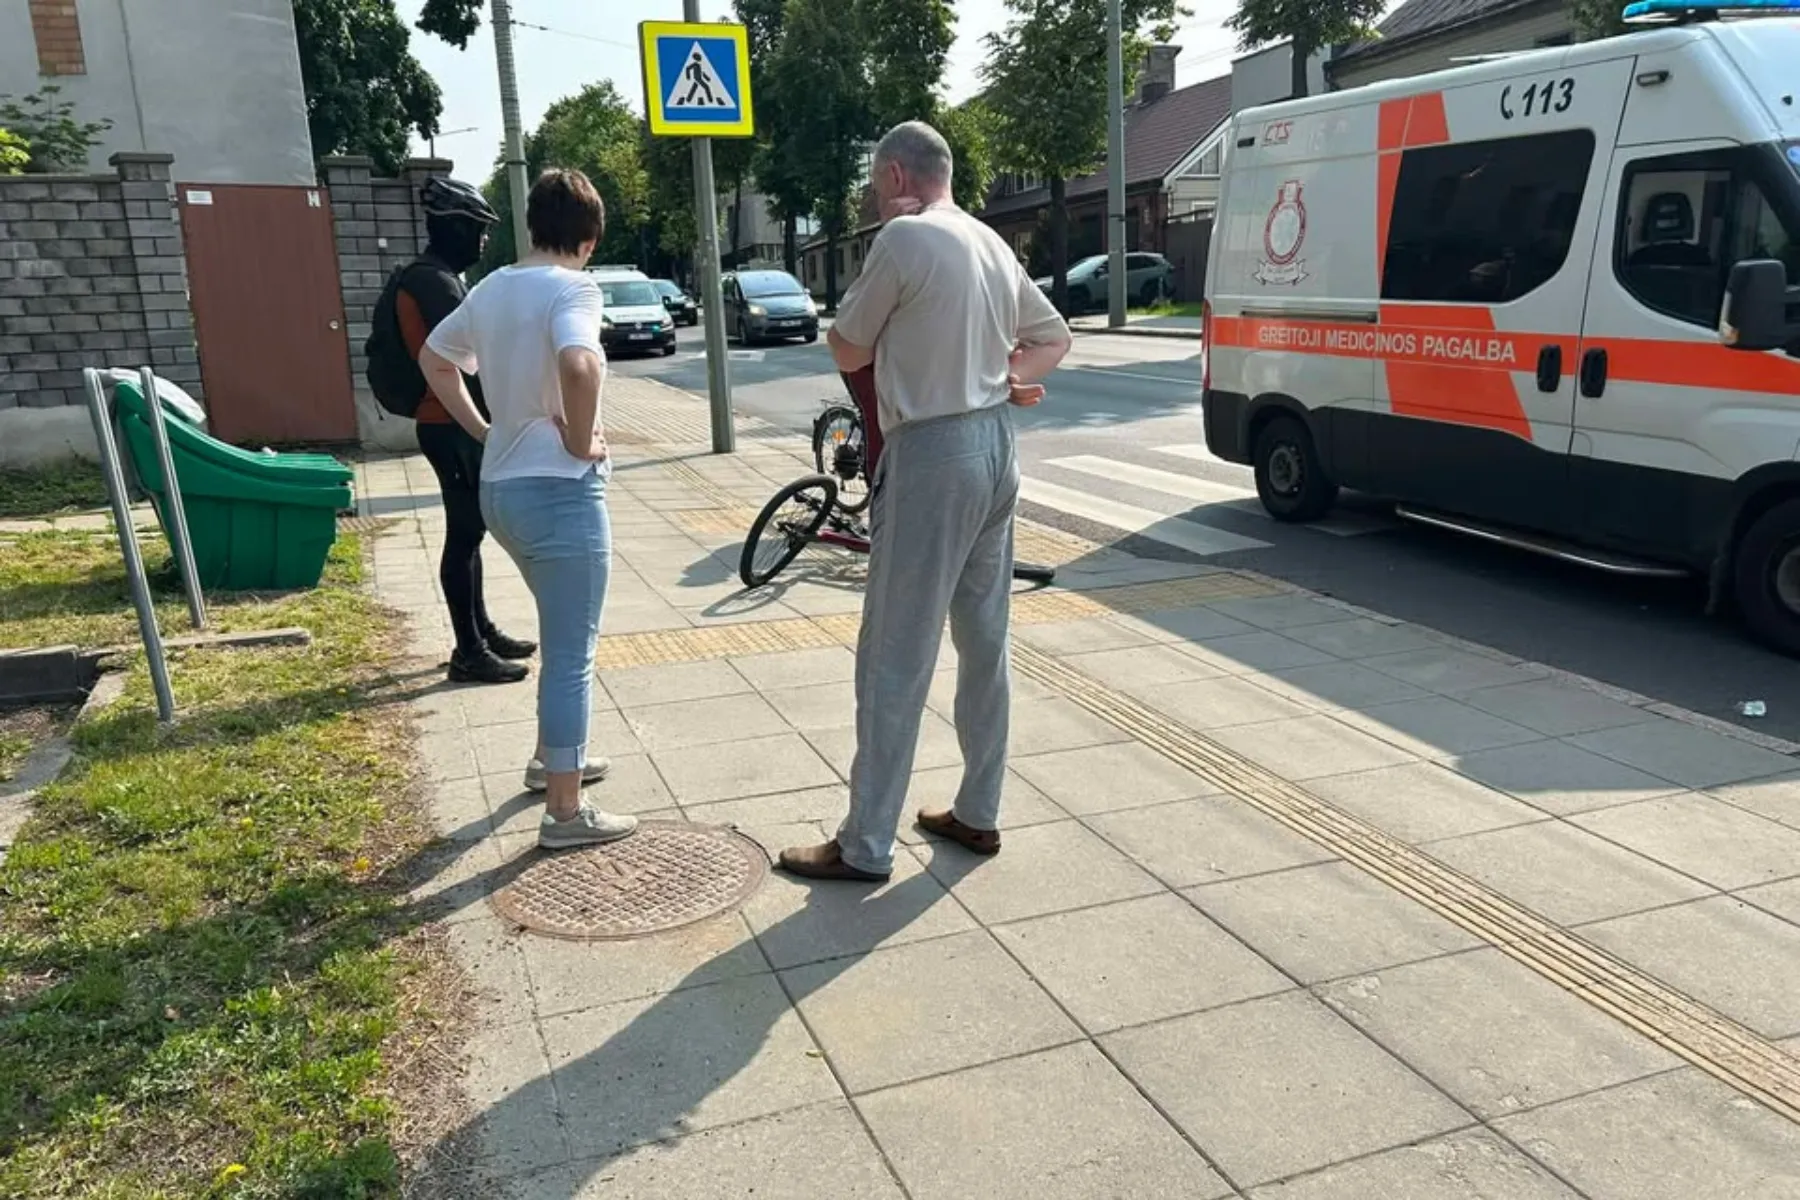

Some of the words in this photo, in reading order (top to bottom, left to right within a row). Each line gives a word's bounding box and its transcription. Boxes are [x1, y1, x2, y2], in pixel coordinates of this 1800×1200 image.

[1522, 77, 1576, 117] 113
[1258, 325, 1321, 348] GREITOJI
[1325, 329, 1417, 354] MEDICINOS
[1422, 335, 1517, 362] PAGALBA
